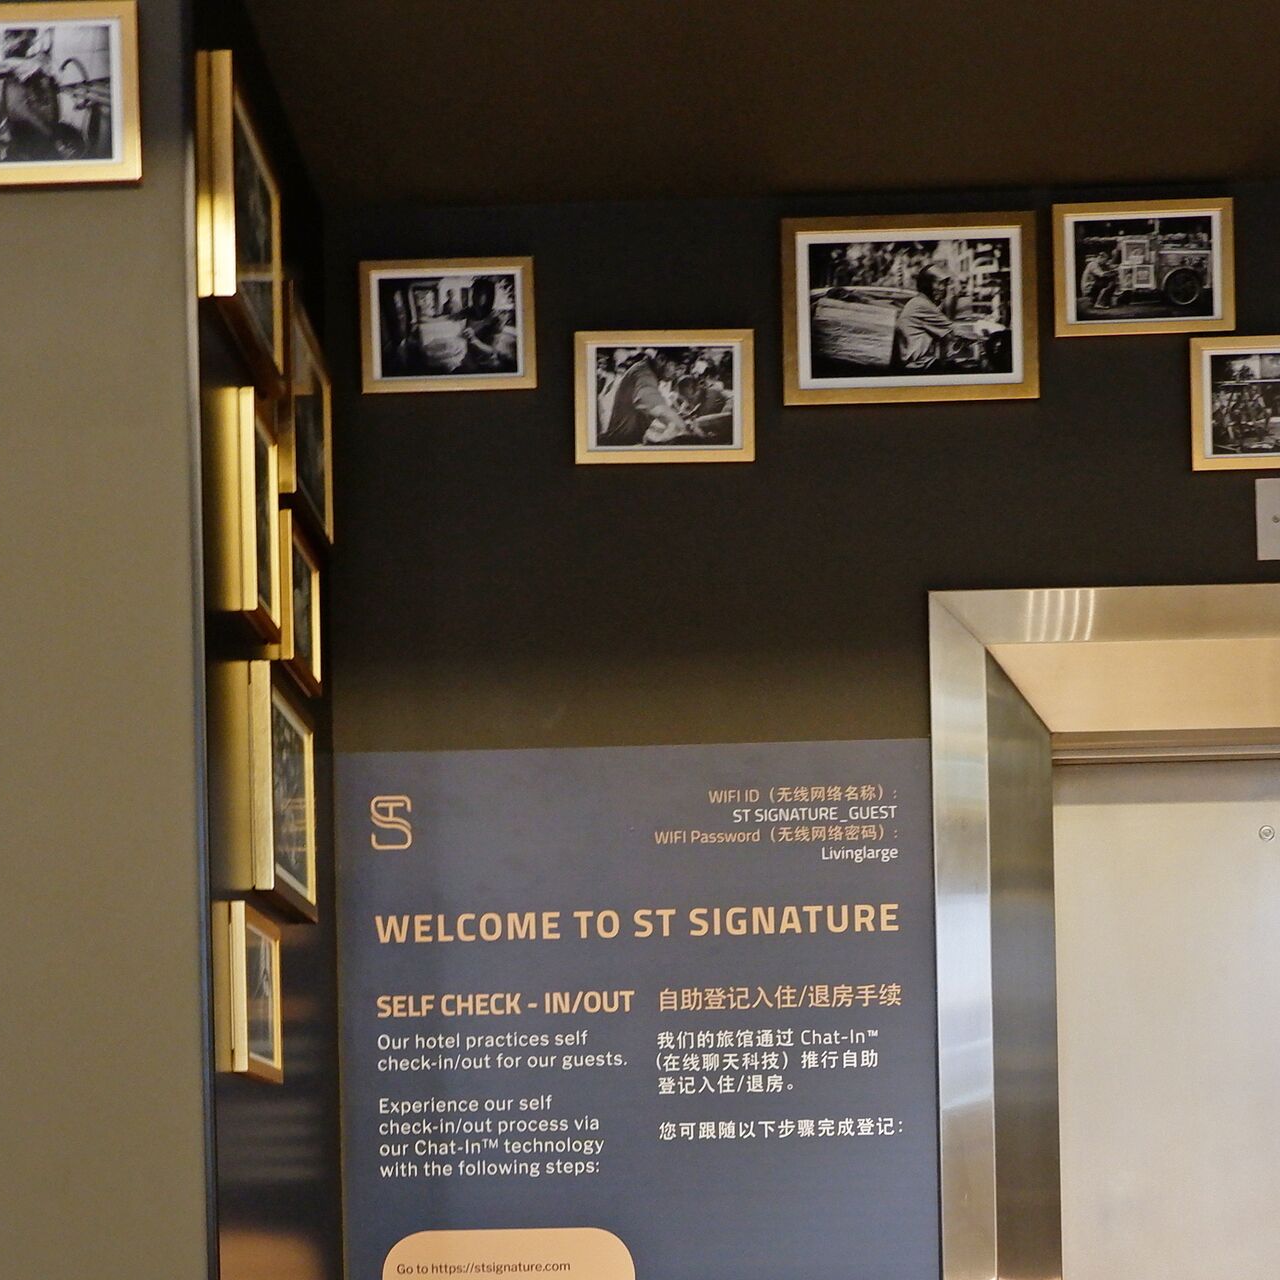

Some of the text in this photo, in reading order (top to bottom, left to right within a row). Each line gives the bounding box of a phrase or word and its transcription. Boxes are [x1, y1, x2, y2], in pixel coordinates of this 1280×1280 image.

[709, 790, 740, 803] WIFI
[745, 790, 759, 802] ID
[733, 806, 897, 822] ST SIGNATURE_GUEST
[655, 829, 760, 844] WIFI Password
[822, 846, 898, 863] Livinglarge
[376, 904, 899, 943] WELCOME TO ST SIGNATURE
[377, 991, 634, 1017] SELF CHECK IN/OUT
[660, 983, 901, 1011] 自助登记入住/退房手续
[378, 1030, 587, 1050] Our hotel practices self
[657, 1028, 794, 1049] 我们的旅馆通过
[378, 1052, 627, 1071] check-in/out for our guests.
[658, 1074, 793, 1094] 登记入住/退房。
[380, 1095, 552, 1116] Experience our self
[379, 1116, 599, 1135] check-in/out process via
[380, 1137, 604, 1156] our technology
[380, 1160, 599, 1177] with the following steps:
[396, 1261, 570, 1275] Go to https://stsignature.com
